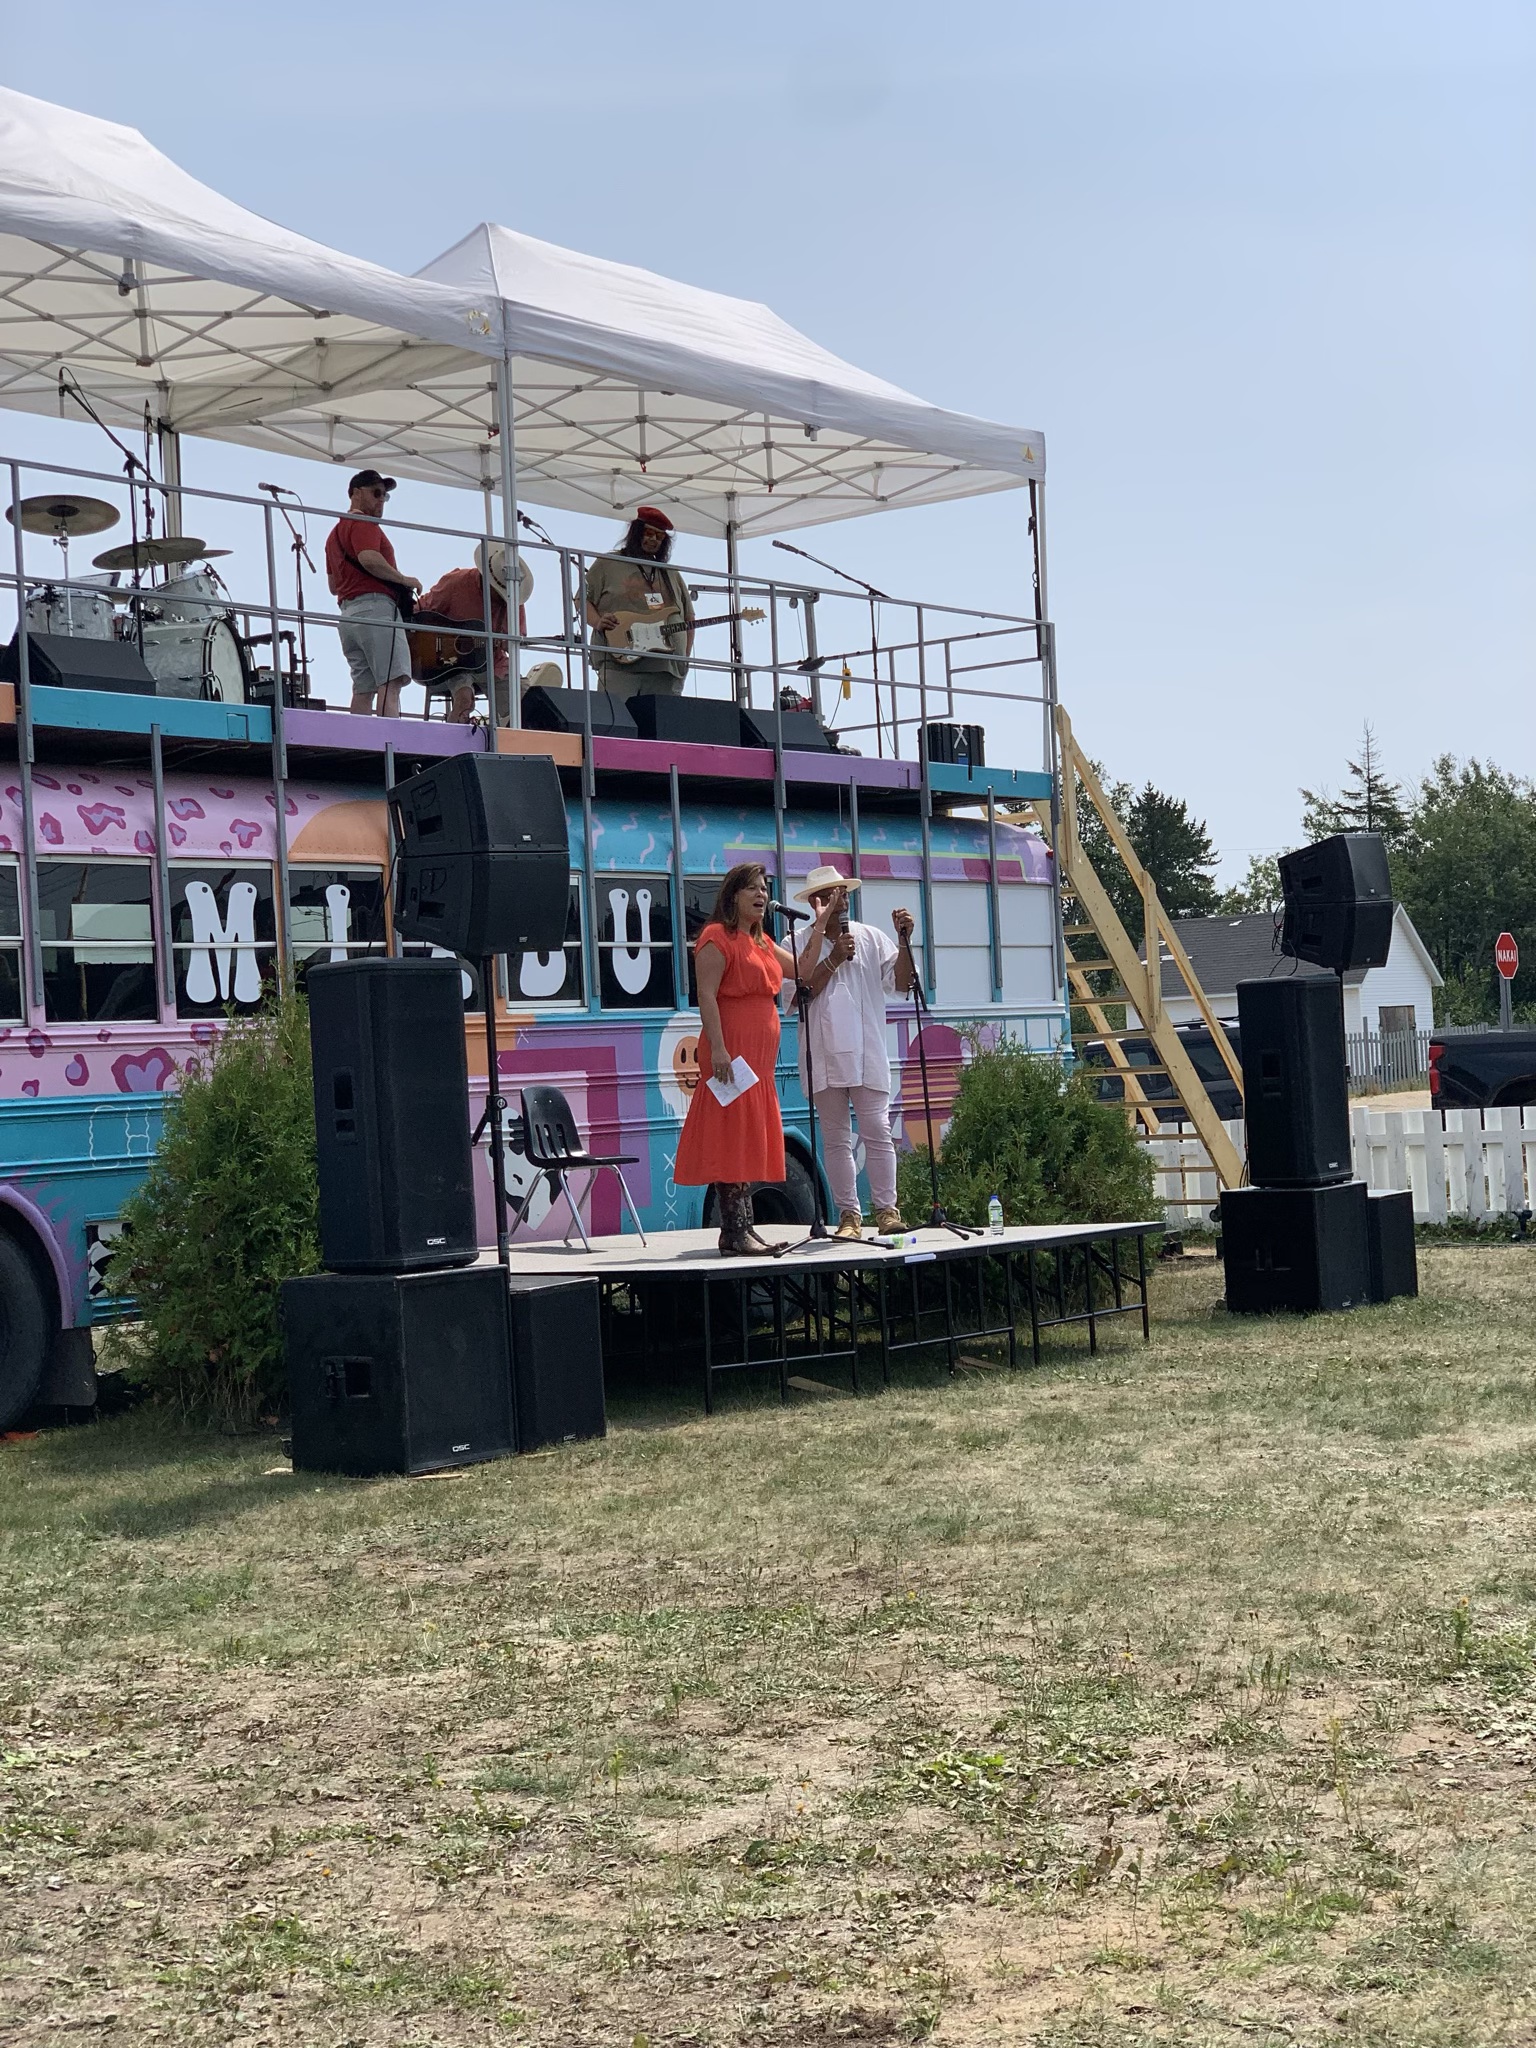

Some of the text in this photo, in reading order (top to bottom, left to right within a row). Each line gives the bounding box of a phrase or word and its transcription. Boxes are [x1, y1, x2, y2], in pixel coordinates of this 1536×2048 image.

[1497, 949, 1517, 963] NAKAI
[426, 1237, 446, 1246] QSC
[452, 1443, 470, 1452] QSC
